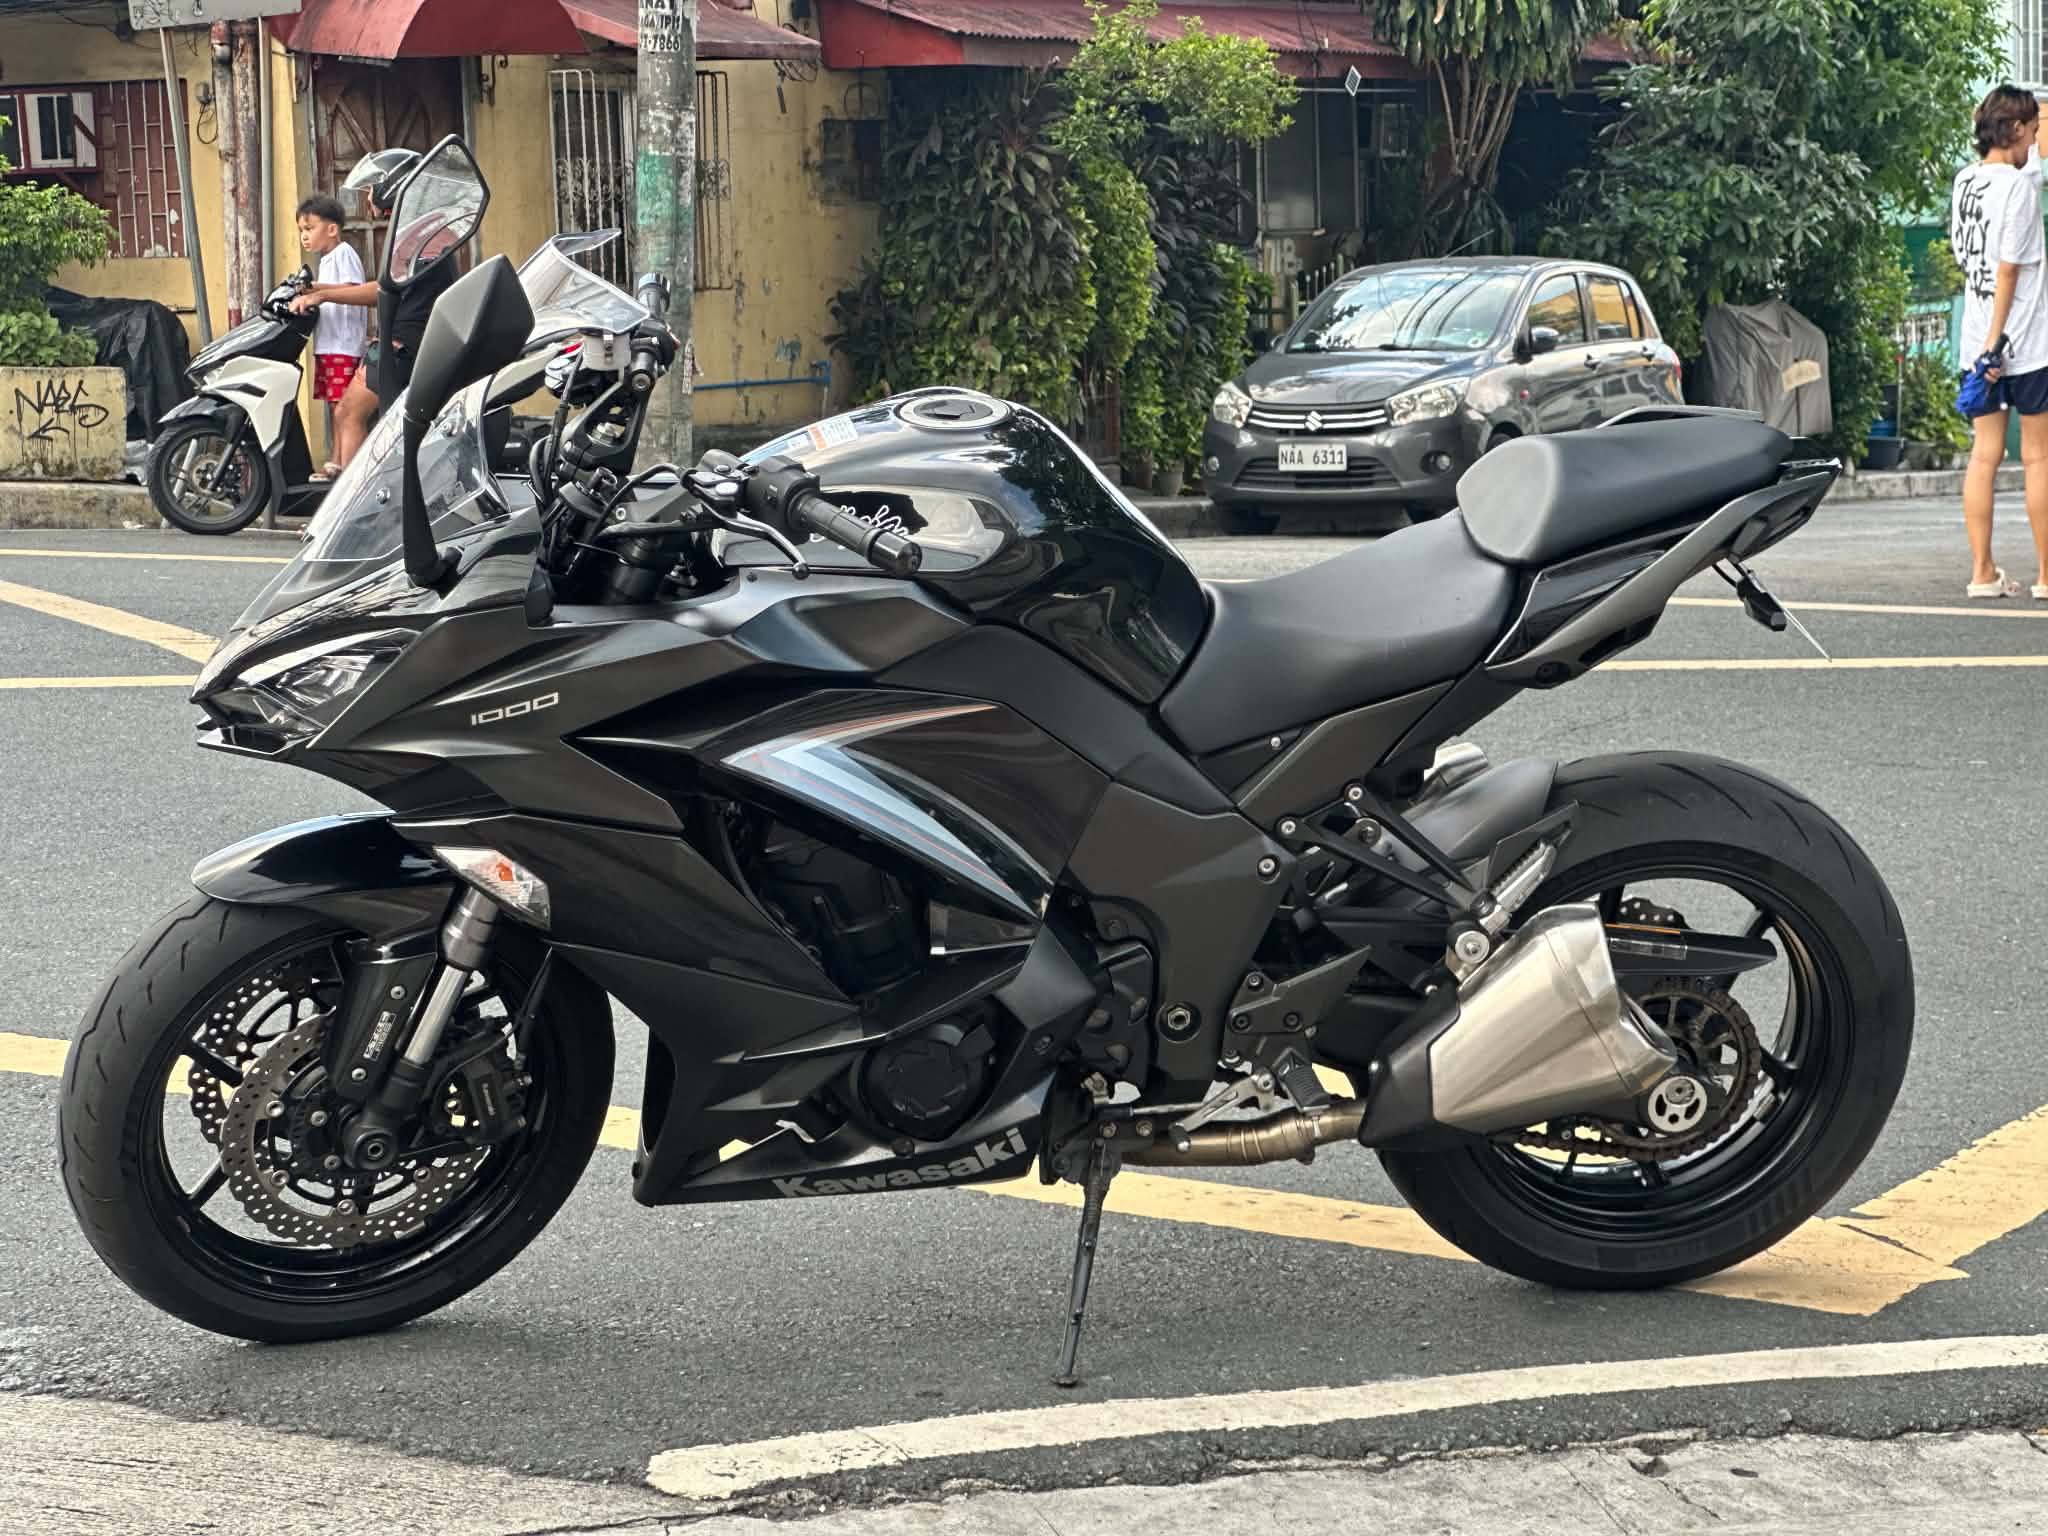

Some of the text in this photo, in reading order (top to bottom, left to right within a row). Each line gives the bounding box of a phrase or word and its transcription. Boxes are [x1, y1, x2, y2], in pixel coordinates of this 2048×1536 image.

[1280, 449, 1344, 465] NAA 6311
[471, 691, 559, 726] 1000
[771, 1127, 1028, 1198] Kawasaki
